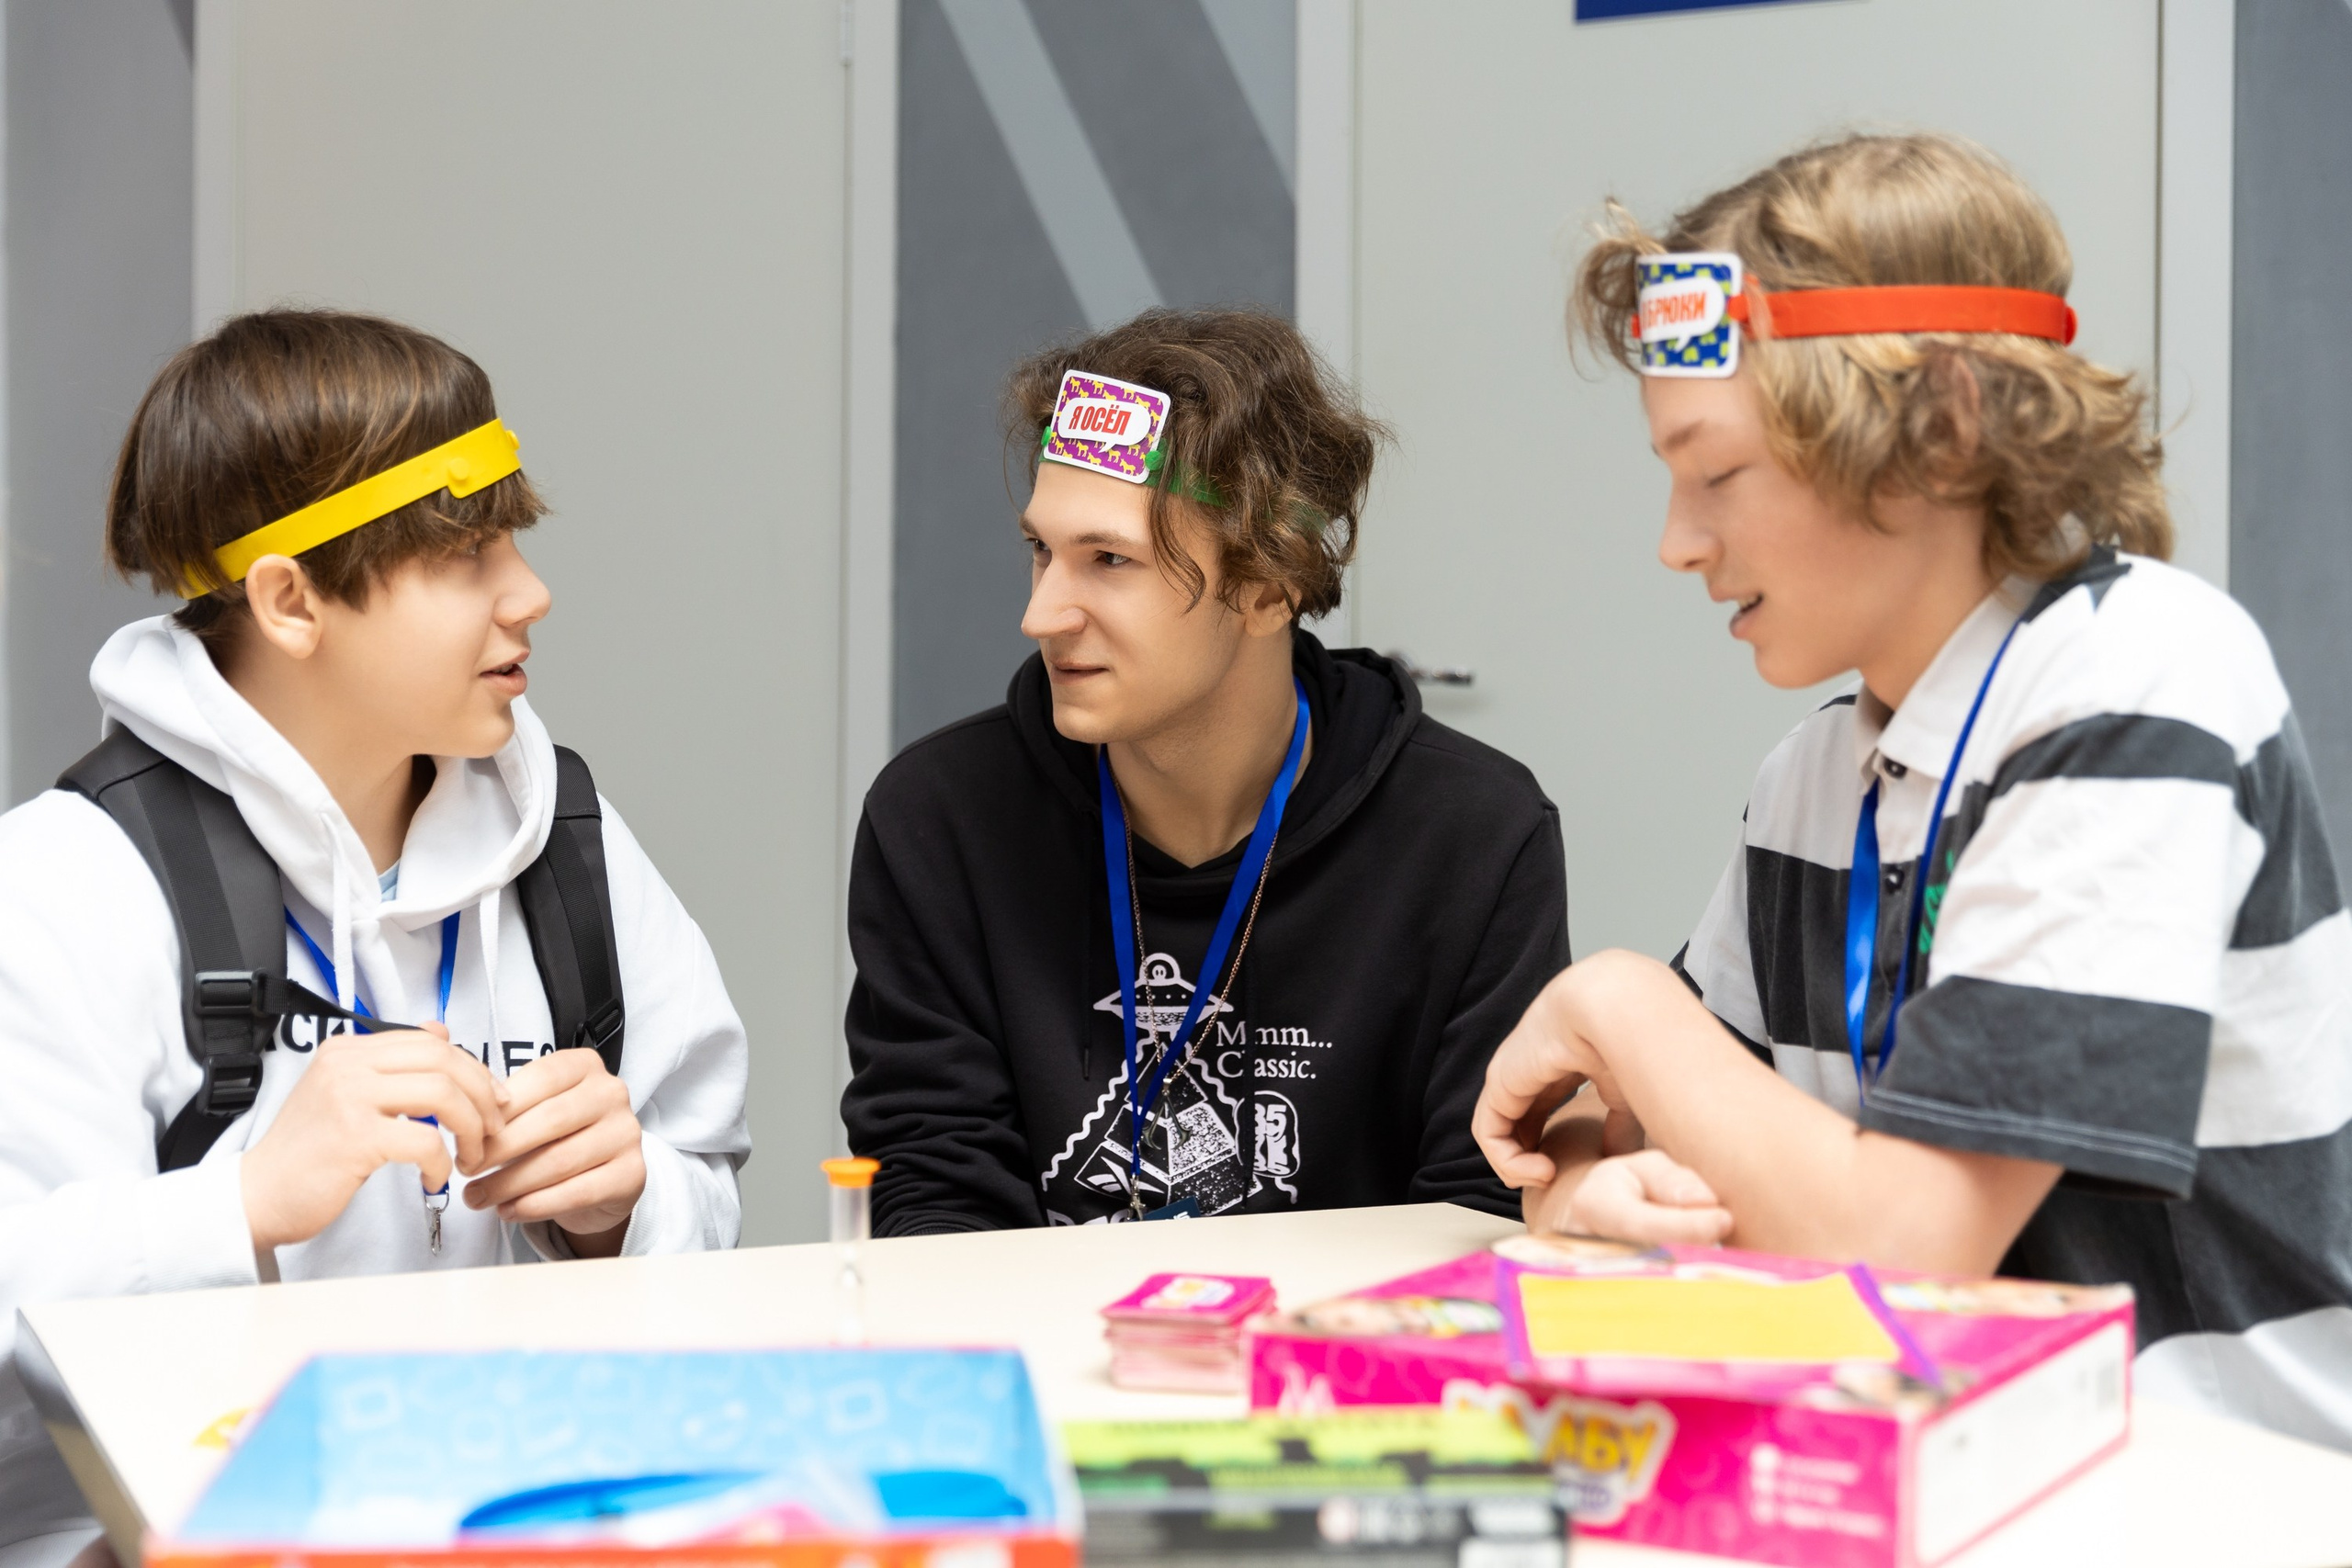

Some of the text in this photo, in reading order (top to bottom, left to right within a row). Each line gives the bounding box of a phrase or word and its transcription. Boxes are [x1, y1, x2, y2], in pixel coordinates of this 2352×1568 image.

[1069, 404, 1132, 435] Я ОСЁЛ
[1216, 1050, 1316, 1079] Cassic.
